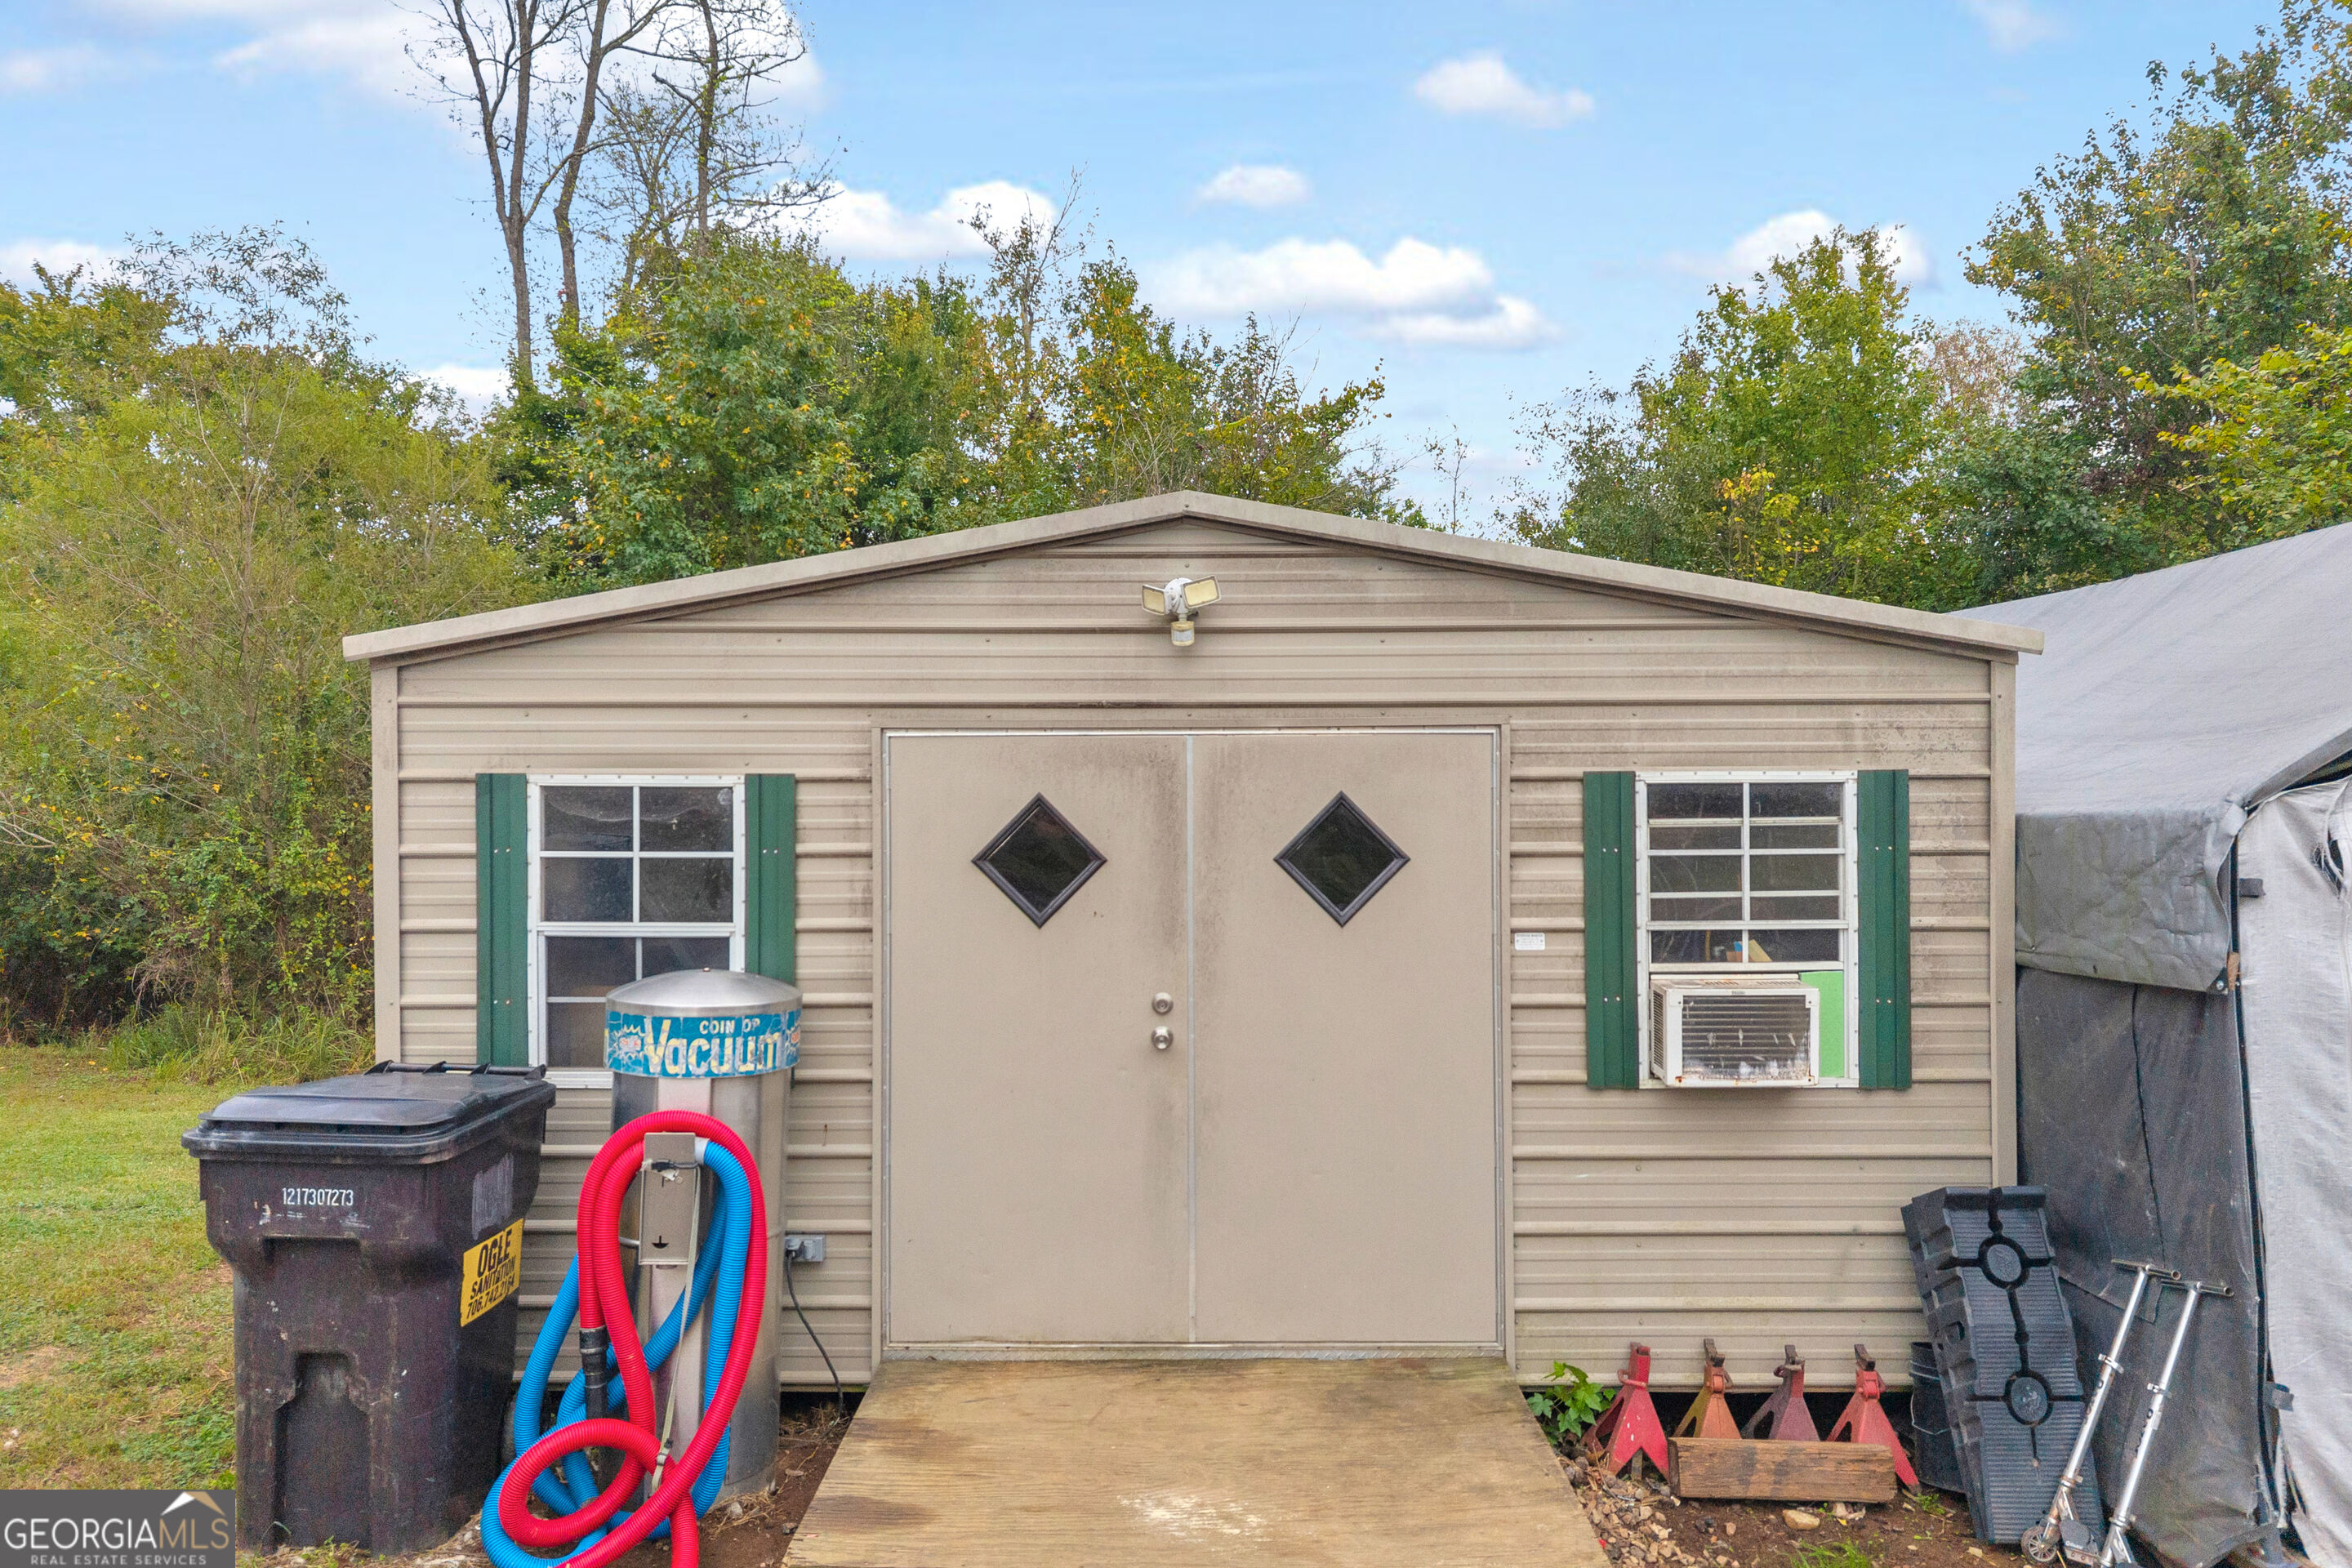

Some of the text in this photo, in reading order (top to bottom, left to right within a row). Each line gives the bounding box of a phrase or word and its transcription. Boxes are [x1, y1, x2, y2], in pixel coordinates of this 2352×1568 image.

[644, 1018, 782, 1075] Vacuum
[699, 1018, 760, 1035] COIN OP
[282, 1187, 354, 1206] 1217307273
[477, 1227, 513, 1278] OGLE
[470, 1254, 516, 1300] SANITATION
